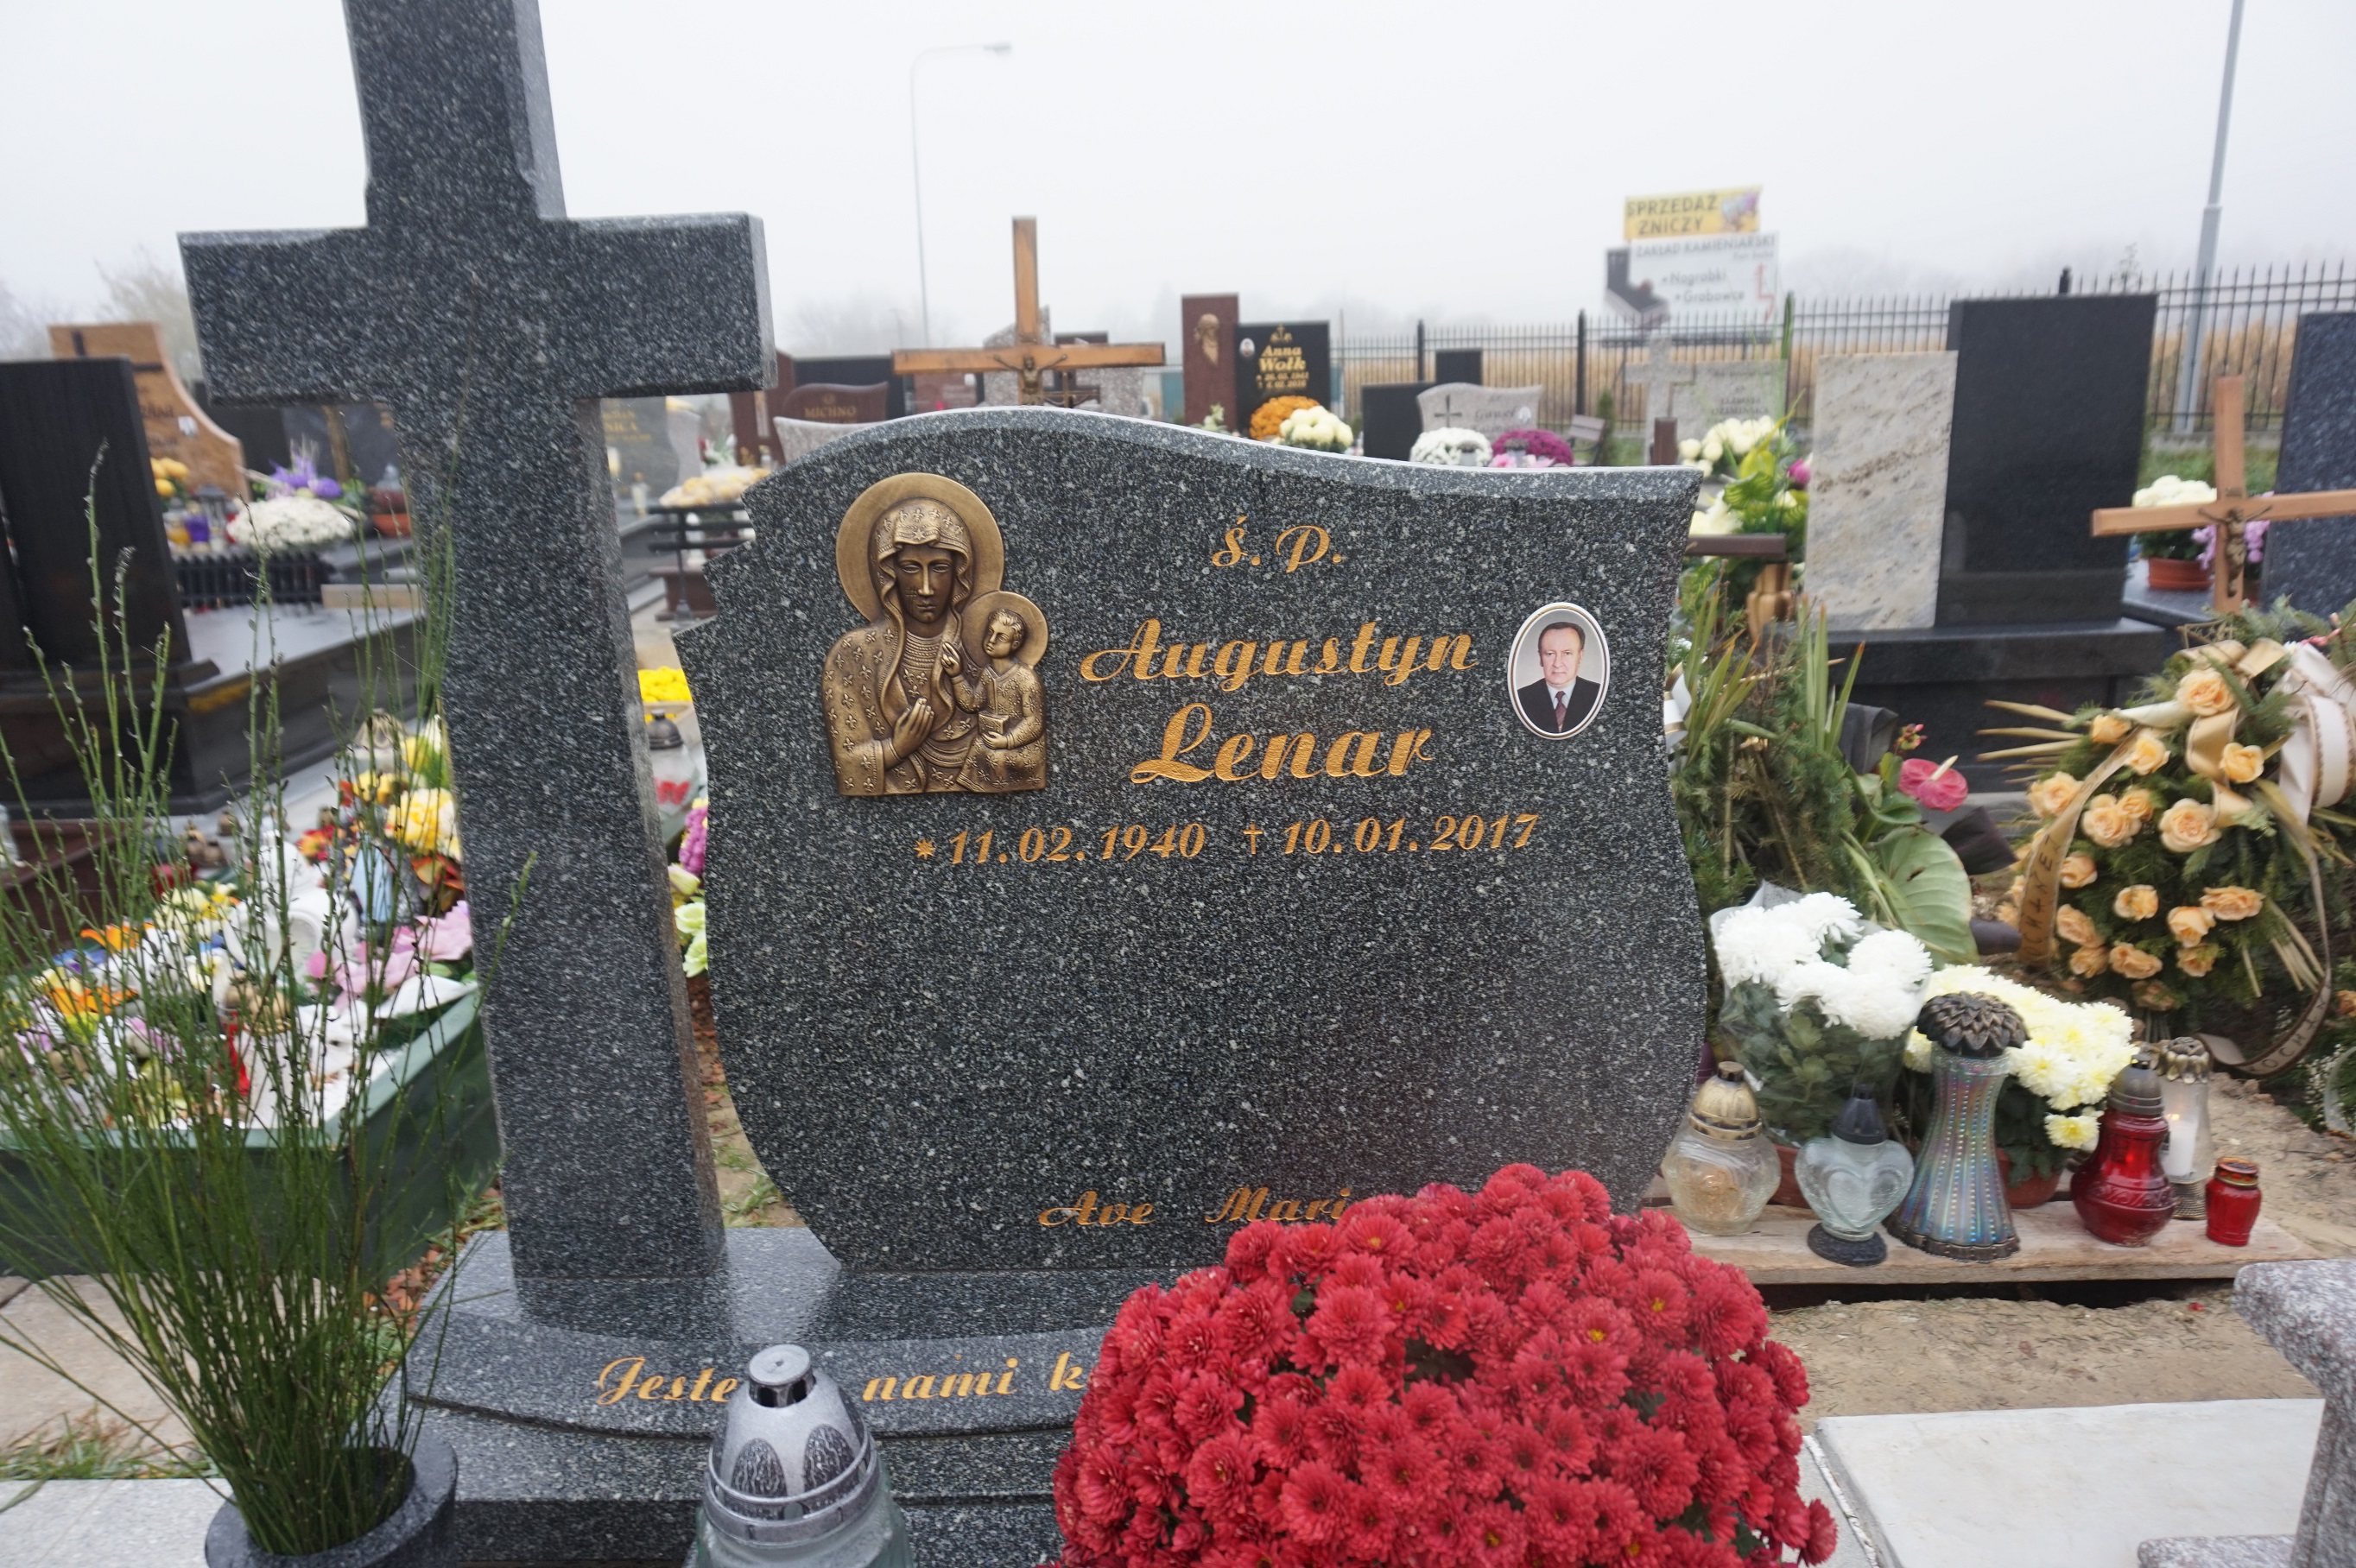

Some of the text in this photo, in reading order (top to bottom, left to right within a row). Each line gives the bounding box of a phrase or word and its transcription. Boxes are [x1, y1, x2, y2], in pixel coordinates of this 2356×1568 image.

[1627, 191, 1718, 217] SPRZEDAŻ
[1638, 215, 1704, 235] ZNICZY
[1685, 234, 1776, 254] KAMIENIARSKI
[1670, 267, 1726, 286] Nagrobki
[1683, 288, 1745, 302] Grobowce
[1261, 345, 1302, 357] Anna
[1079, 617, 1479, 692] Augustyn
[1130, 702, 1433, 784] Lenar
[1037, 1186, 1352, 1226] Ave Mari
[597, 1350, 1087, 1407] Jeste nami k
